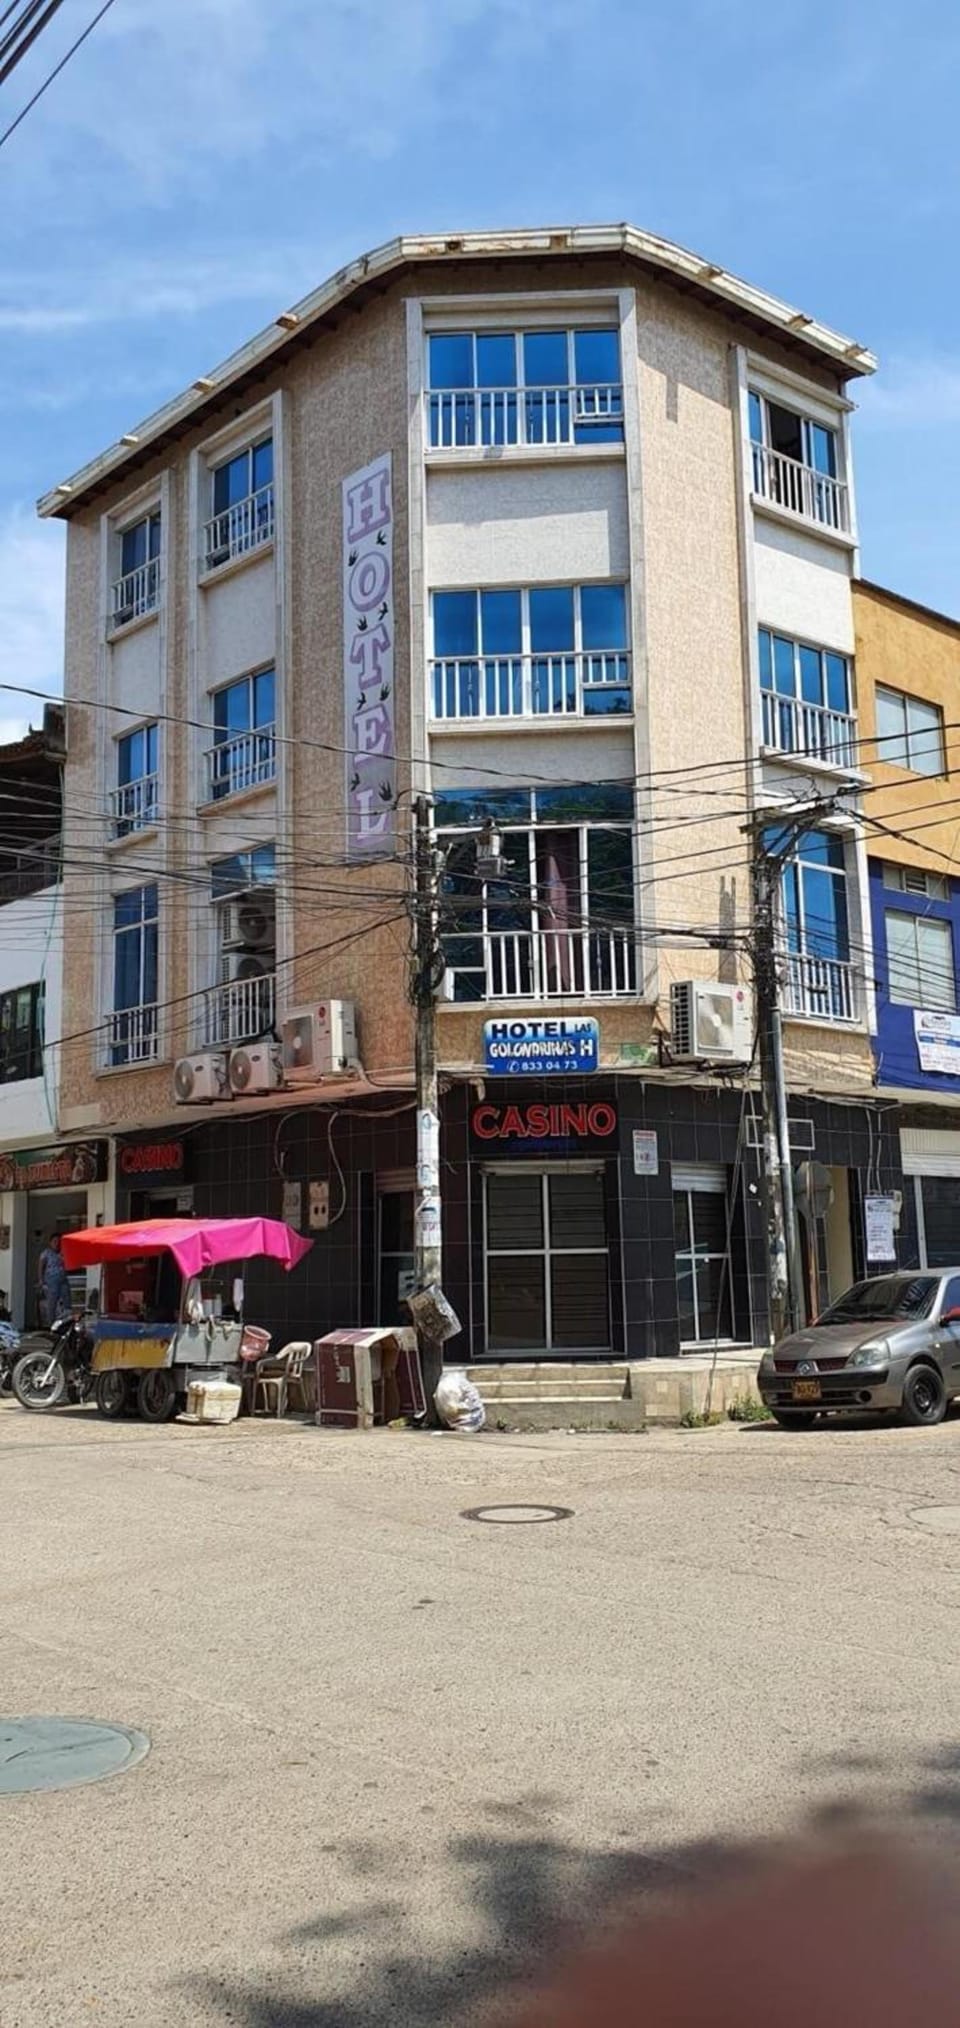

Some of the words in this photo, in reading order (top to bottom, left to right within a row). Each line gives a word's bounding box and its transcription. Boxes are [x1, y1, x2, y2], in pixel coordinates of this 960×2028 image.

[347, 467, 392, 846] HOTEL
[491, 1022, 572, 1039] HOTEL
[575, 1023, 593, 1033] LAS
[521, 1061, 543, 1071] 833
[546, 1061, 561, 1070] 04
[565, 1060, 578, 1070] 73
[472, 1103, 616, 1139] CASINO
[121, 1142, 183, 1173] CASINO
